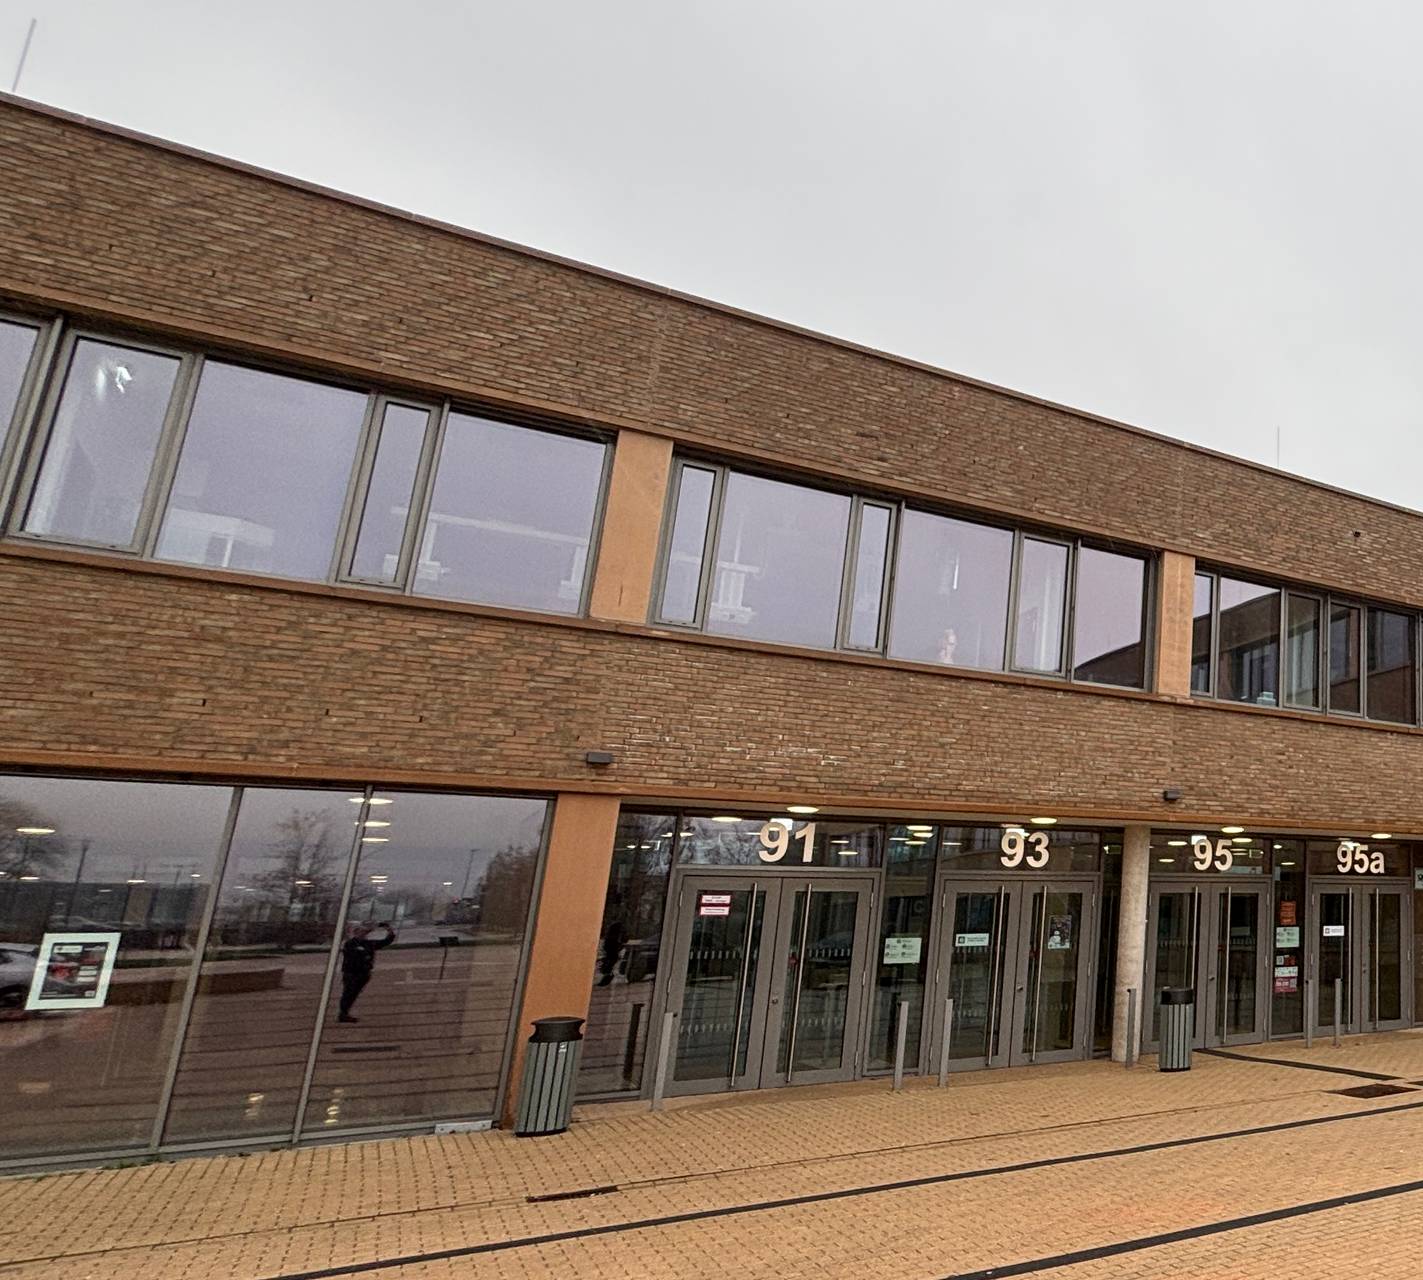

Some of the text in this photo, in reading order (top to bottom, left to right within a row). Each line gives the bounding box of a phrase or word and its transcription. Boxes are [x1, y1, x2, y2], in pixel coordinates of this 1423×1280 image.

[758, 822, 816, 862] 91
[1000, 831, 1050, 867] 93
[1194, 838, 1233, 871] 95
[1336, 844, 1385, 873] 95a
